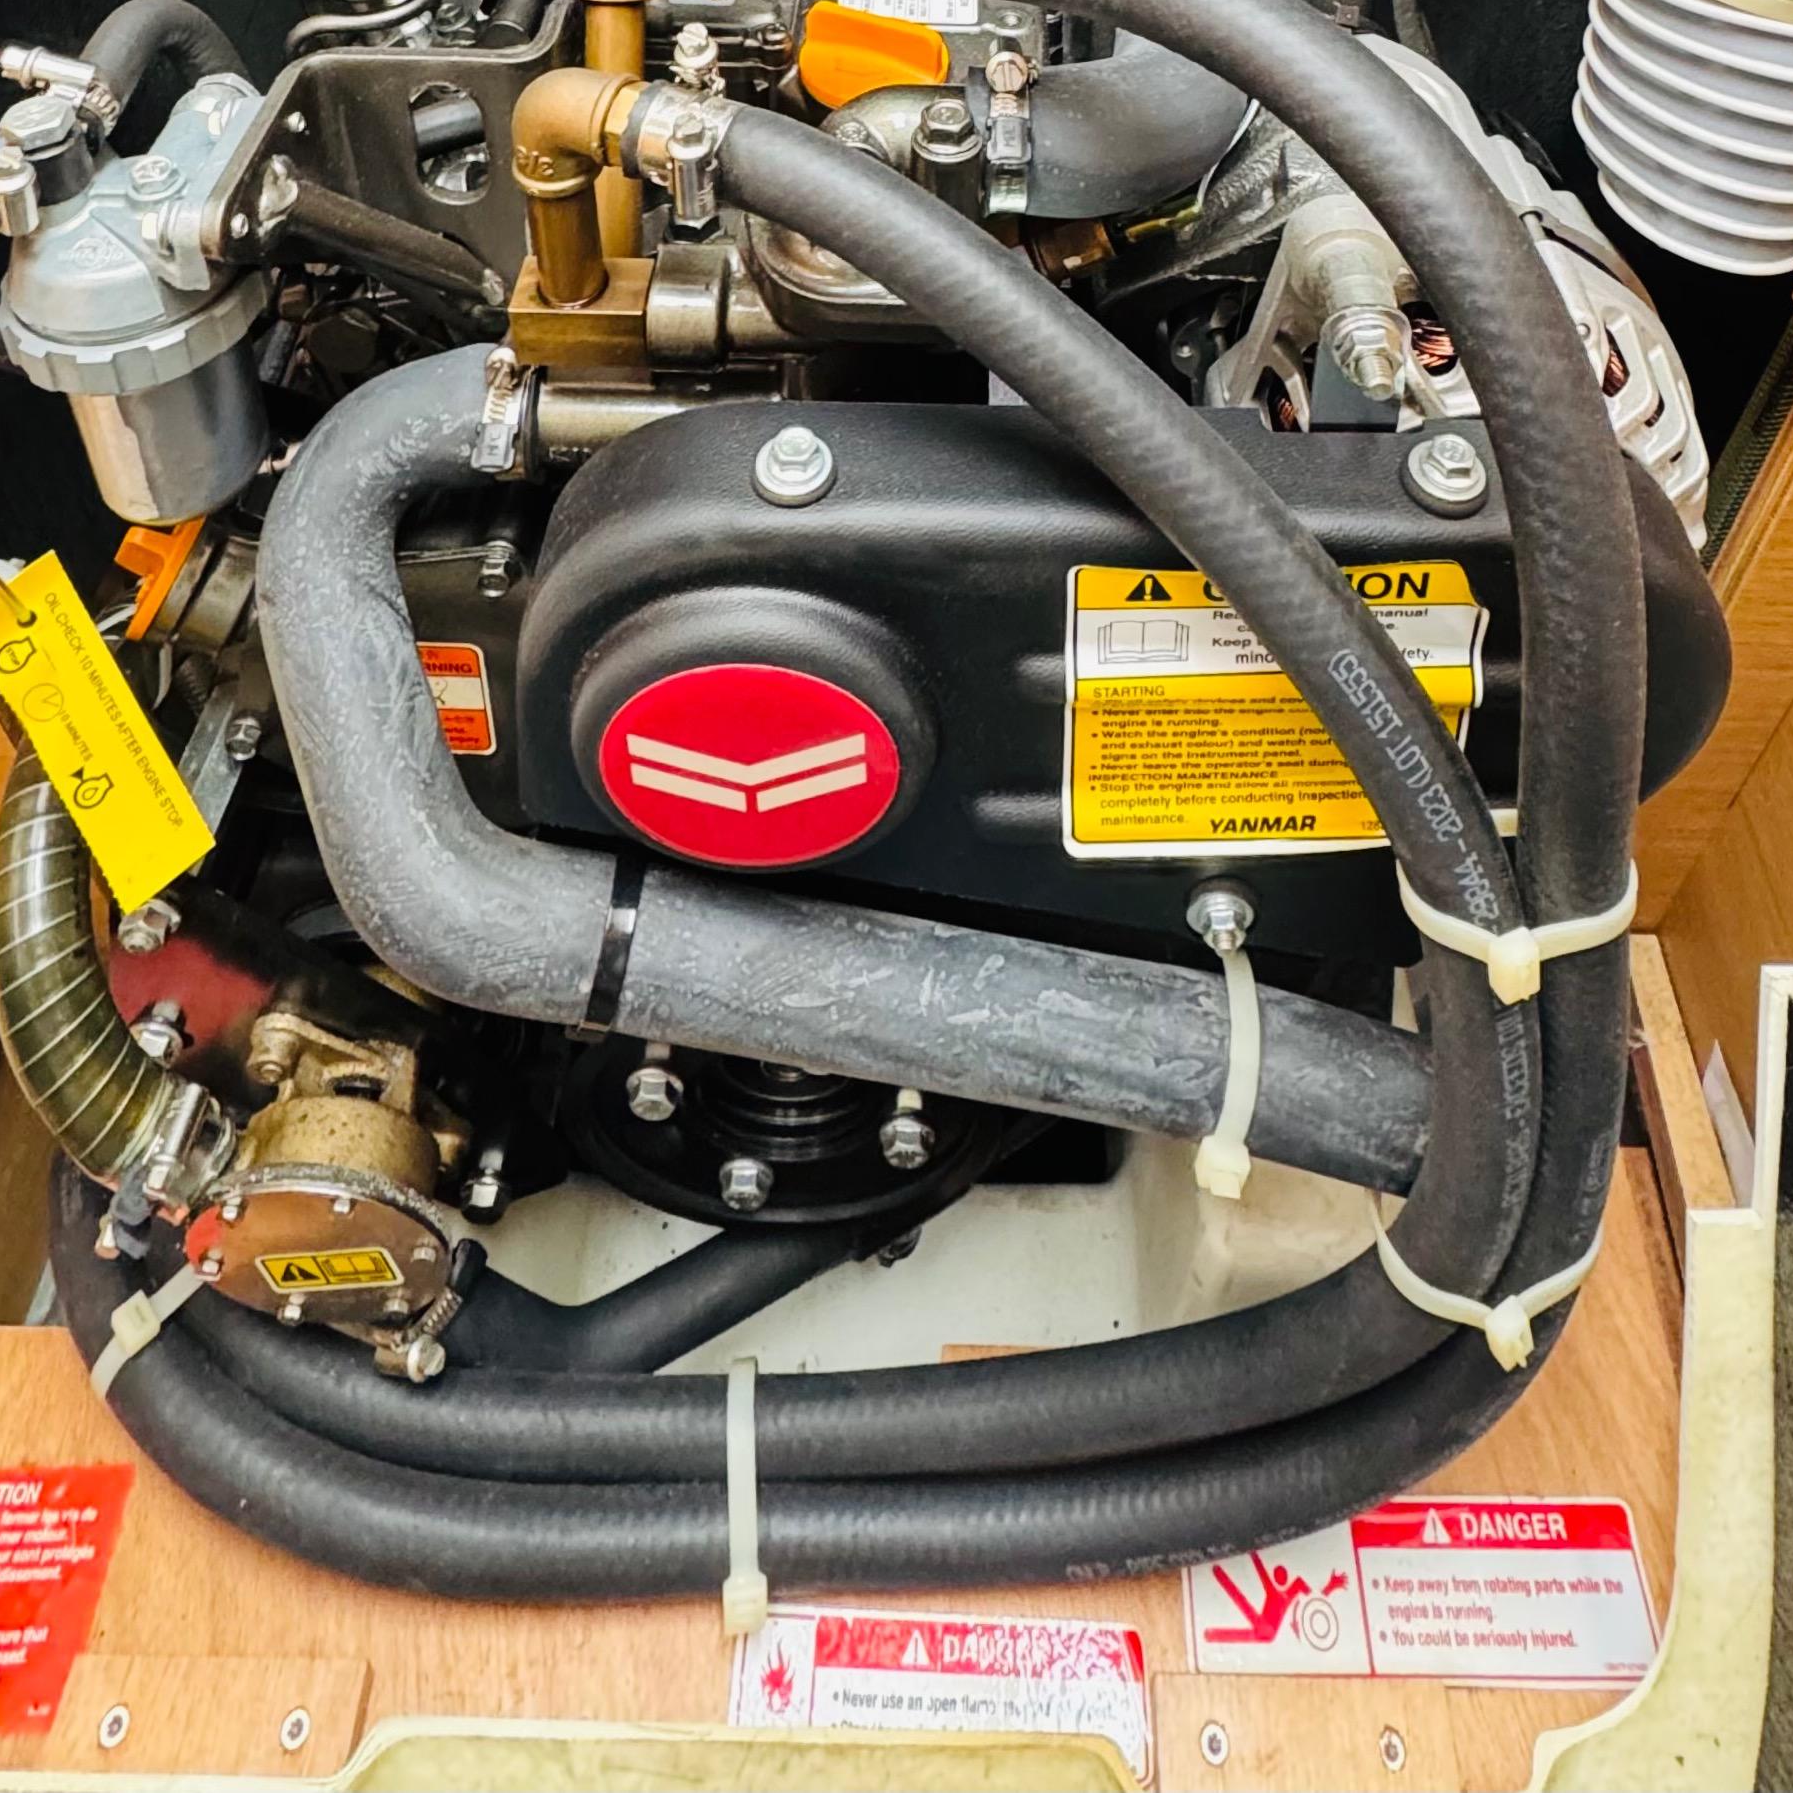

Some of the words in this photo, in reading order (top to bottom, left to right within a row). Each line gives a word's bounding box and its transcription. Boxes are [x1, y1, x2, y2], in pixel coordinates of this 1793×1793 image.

[44, 592, 56, 614] OIL
[55, 613, 85, 653] CHECK
[79, 654, 93, 671] 10
[87, 666, 122, 722] MINUTES
[117, 719, 142, 757] AFTER
[136, 755, 166, 802] ENGINE
[1092, 686, 1166, 699] STARTING
[1326, 650, 1406, 742] 151555)
[1102, 719, 1147, 729] engine
[1102, 731, 1143, 739] Watch
[1147, 730, 1168, 738] the
[1172, 728, 1229, 739] engine's
[1232, 727, 1296, 737] condition
[1101, 742, 1126, 750] and
[1130, 741, 1183, 749] exhaust
[1186, 740, 1234, 749] colour)
[1238, 739, 1263, 747] and
[1267, 738, 1306, 746] watch
[1101, 752, 1137, 762] signs
[1162, 751, 1183, 759] the
[1187, 749, 1259, 759] instrument
[1143, 762, 1177, 770] leave
[1181, 761, 1202, 769] the
[1205, 760, 1273, 769] operator's
[1089, 773, 1173, 782] INSPECTION
[1176, 770, 1279, 781] MAINTENANCE
[1100, 783, 1130, 794] Stop
[1134, 783, 1154, 791] the
[1159, 782, 1202, 792] engine
[1205, 780, 1231, 789] and
[1235, 780, 1269, 789] allow
[1100, 794, 1171, 810] completely
[1175, 794, 1217, 806] before
[1221, 791, 1294, 805] conducting
[1414, 782, 1464, 844] 2023
[1209, 814, 1317, 834] YANMAR
[1458, 1511, 1569, 1542] DANGER
[1384, 1576, 1414, 1596] Keep
[1418, 1579, 1449, 1597] away
[1452, 1575, 1481, 1594] from
[1484, 1576, 1532, 1597] rotating
[1534, 1577, 1566, 1597] parts
[1568, 1576, 1602, 1593] while
[1604, 1576, 1624, 1594] the
[1388, 1603, 1430, 1621] engine
[1432, 1604, 1443, 1620] is
[22, 1625, 50, 1644] that
[1392, 1630, 1416, 1647] You
[1418, 1629, 1452, 1647] could
[1455, 1630, 1470, 1647] be
[1473, 1630, 1528, 1653] seriously
[1531, 1629, 1579, 1648] injured.
[842, 1688, 878, 1708] Never
[881, 1693, 904, 1710] use
[907, 1694, 923, 1711] an
